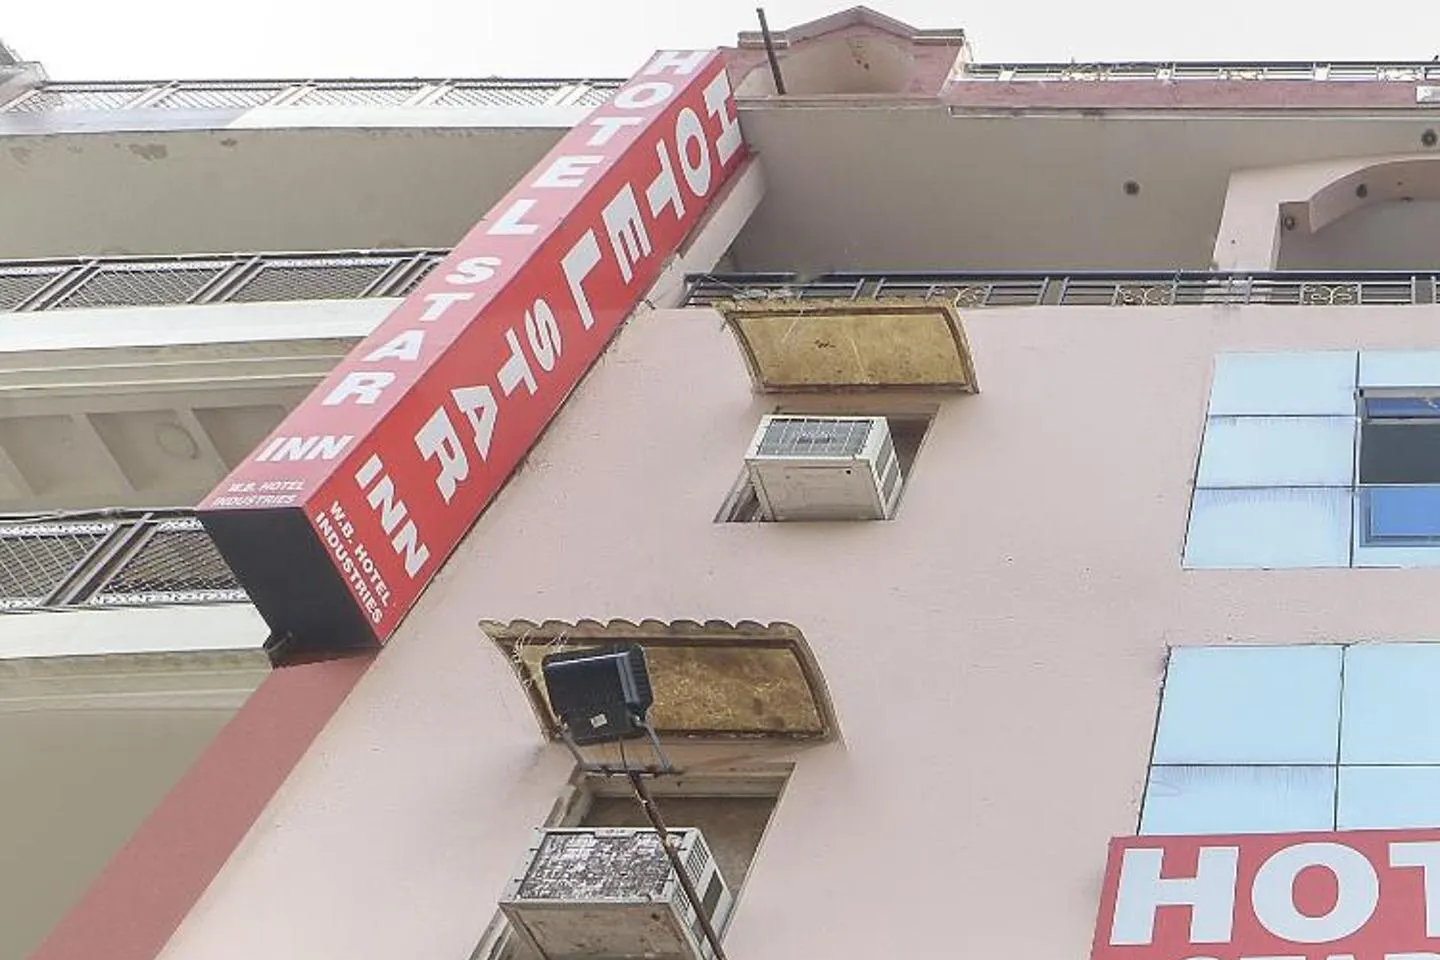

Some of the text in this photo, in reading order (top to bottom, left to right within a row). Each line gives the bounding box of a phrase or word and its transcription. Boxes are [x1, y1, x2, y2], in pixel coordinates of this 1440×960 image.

[255, 51, 710, 461] HOTEL STAR INN
[354, 68, 743, 579] HOTEL STAR INN
[212, 494, 298, 506] INDUSTRIES
[258, 480, 305, 491] HOTEL
[315, 511, 384, 624] INDUSTRIES
[330, 500, 392, 607] W.B. HOTEL
